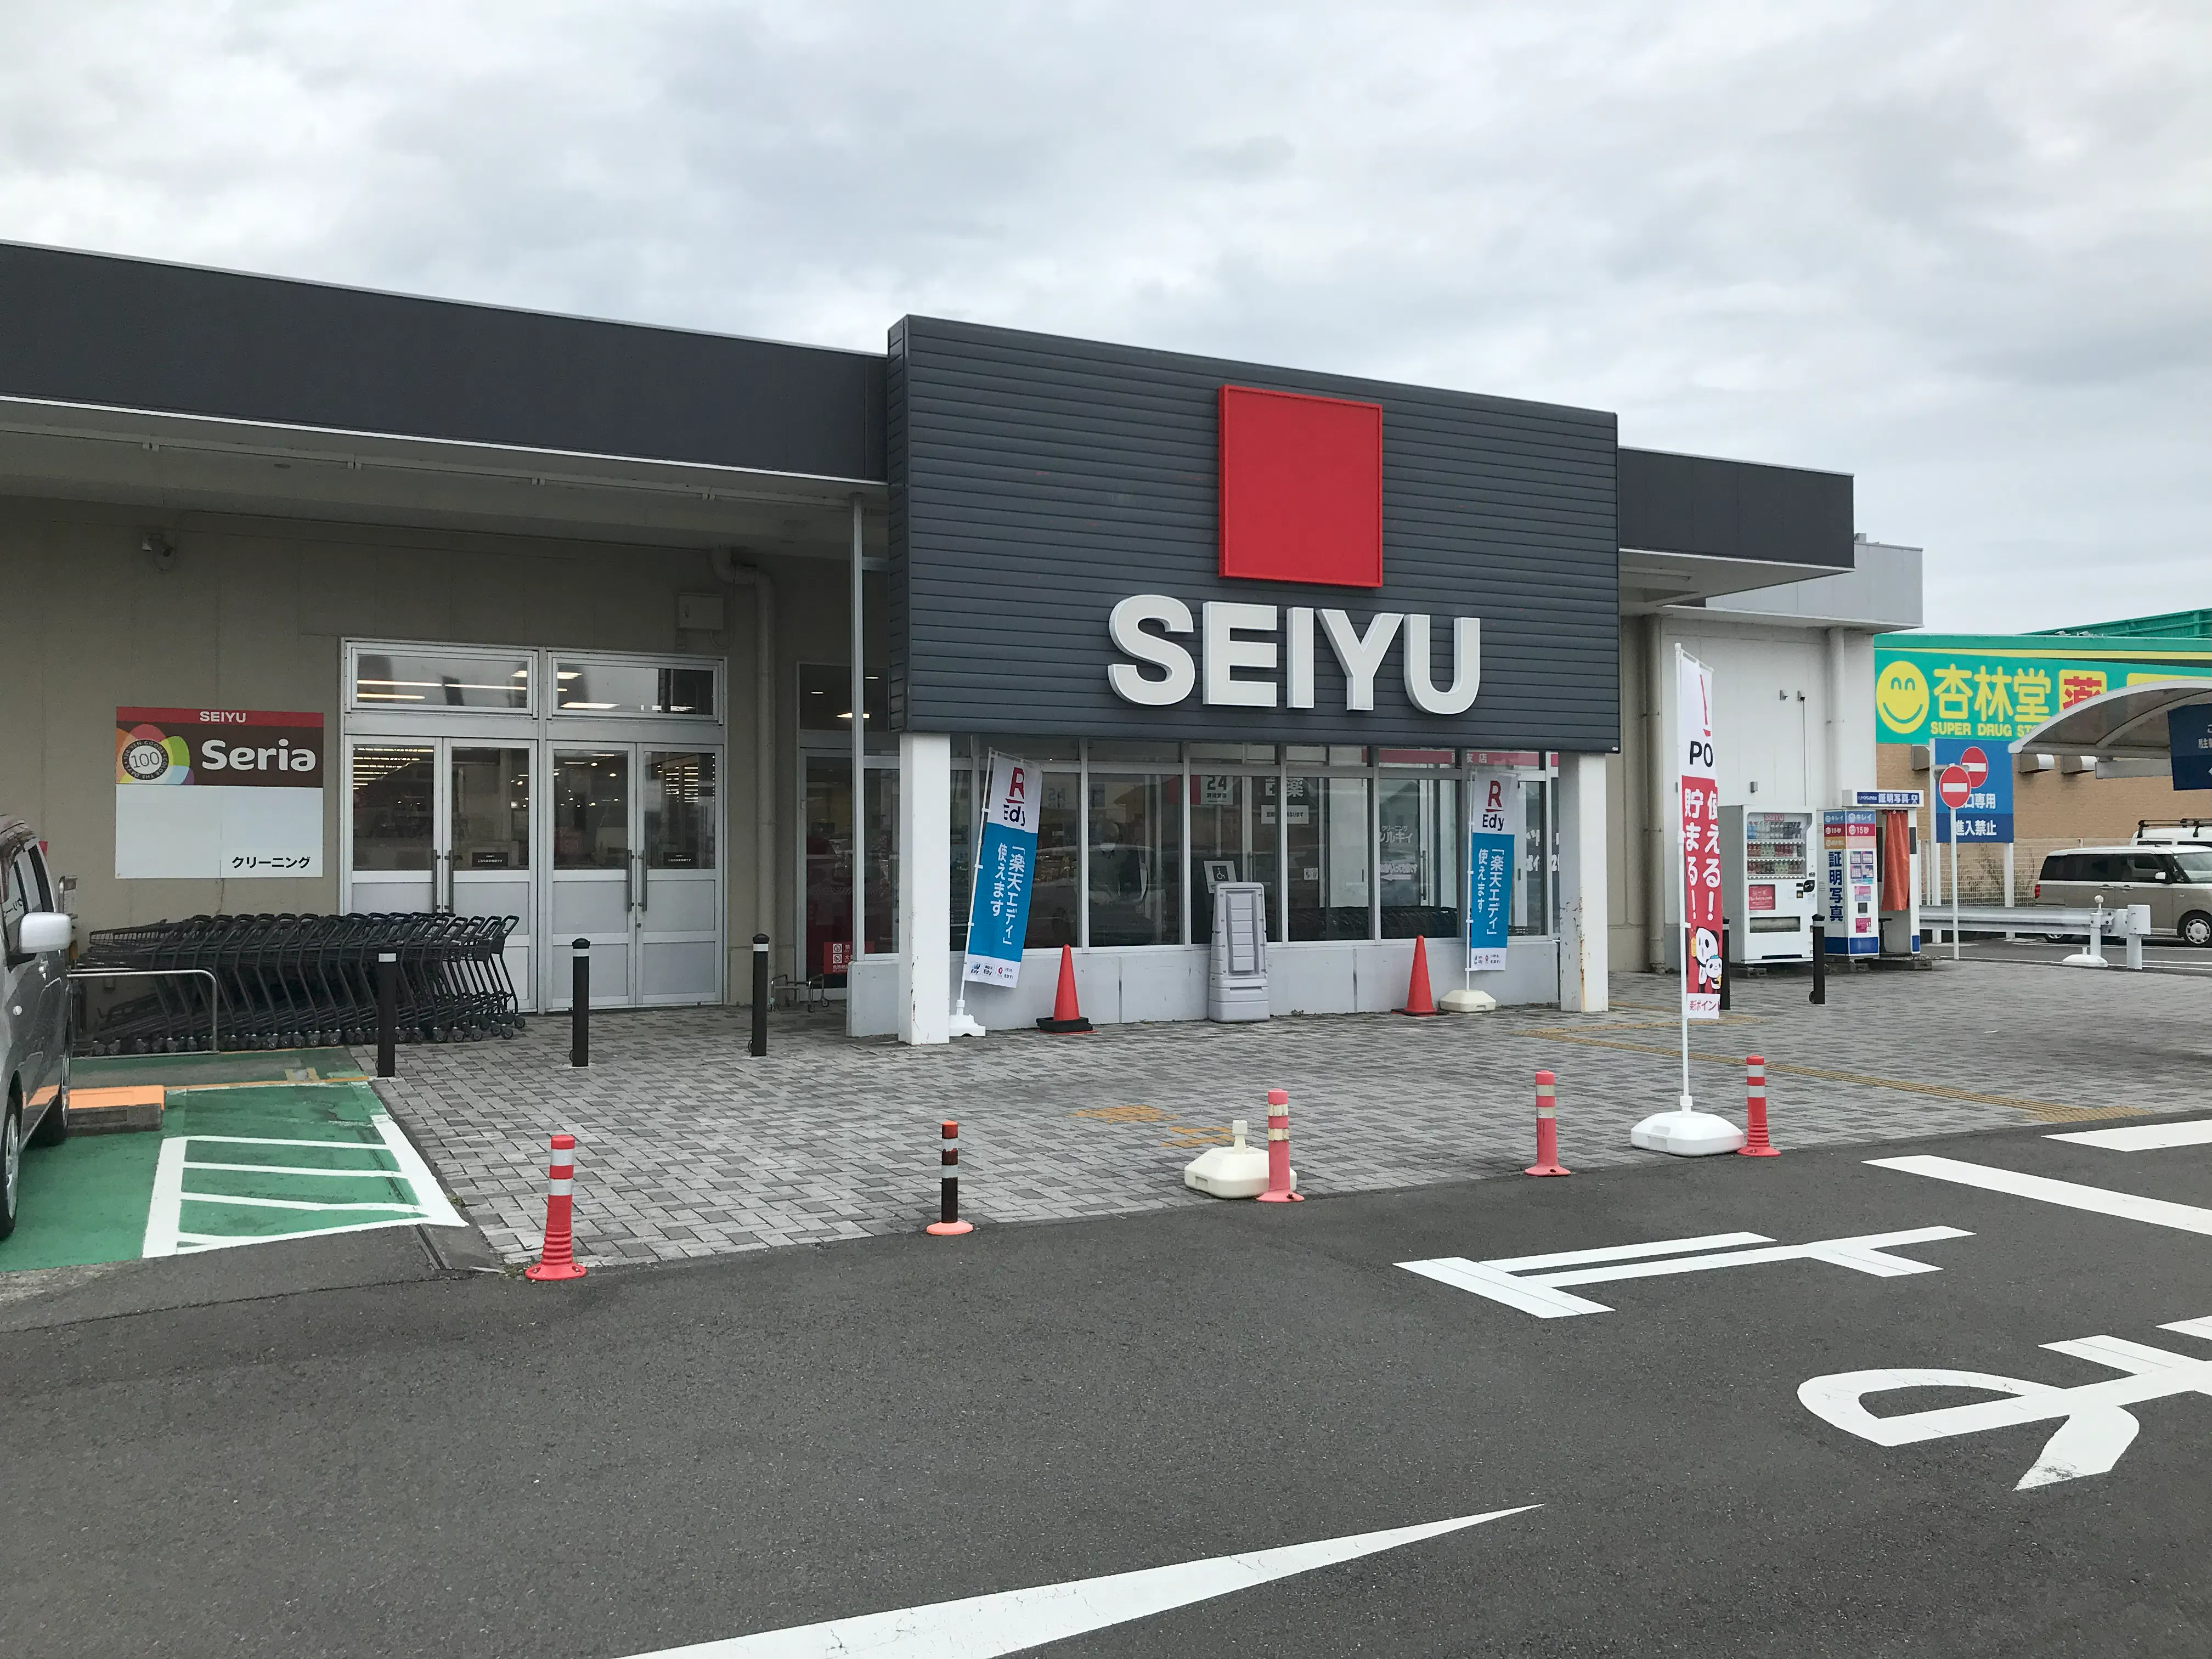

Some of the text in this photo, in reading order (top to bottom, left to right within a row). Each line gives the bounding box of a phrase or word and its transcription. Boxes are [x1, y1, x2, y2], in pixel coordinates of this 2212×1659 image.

[1108, 594, 1481, 714] SEIYU
[1933, 663, 2051, 723] 杏林堂
[200, 711, 246, 723] SEIYU
[1931, 723, 1971, 736] SUPER
[1977, 724, 2012, 736] DRUG
[131, 752, 159, 768] 100
[201, 738, 317, 771] Seria
[1878, 793, 1909, 803] 証明写真
[1961, 793, 1996, 809] 口専用
[1482, 814, 1504, 831] Edy
[1955, 820, 1997, 836] 進入禁止
[232, 856, 311, 869] クリーニング
[990, 842, 1007, 917] 使えます
[1477, 848, 1488, 913] 使えます
[1829, 851, 1843, 922] 証明写真
